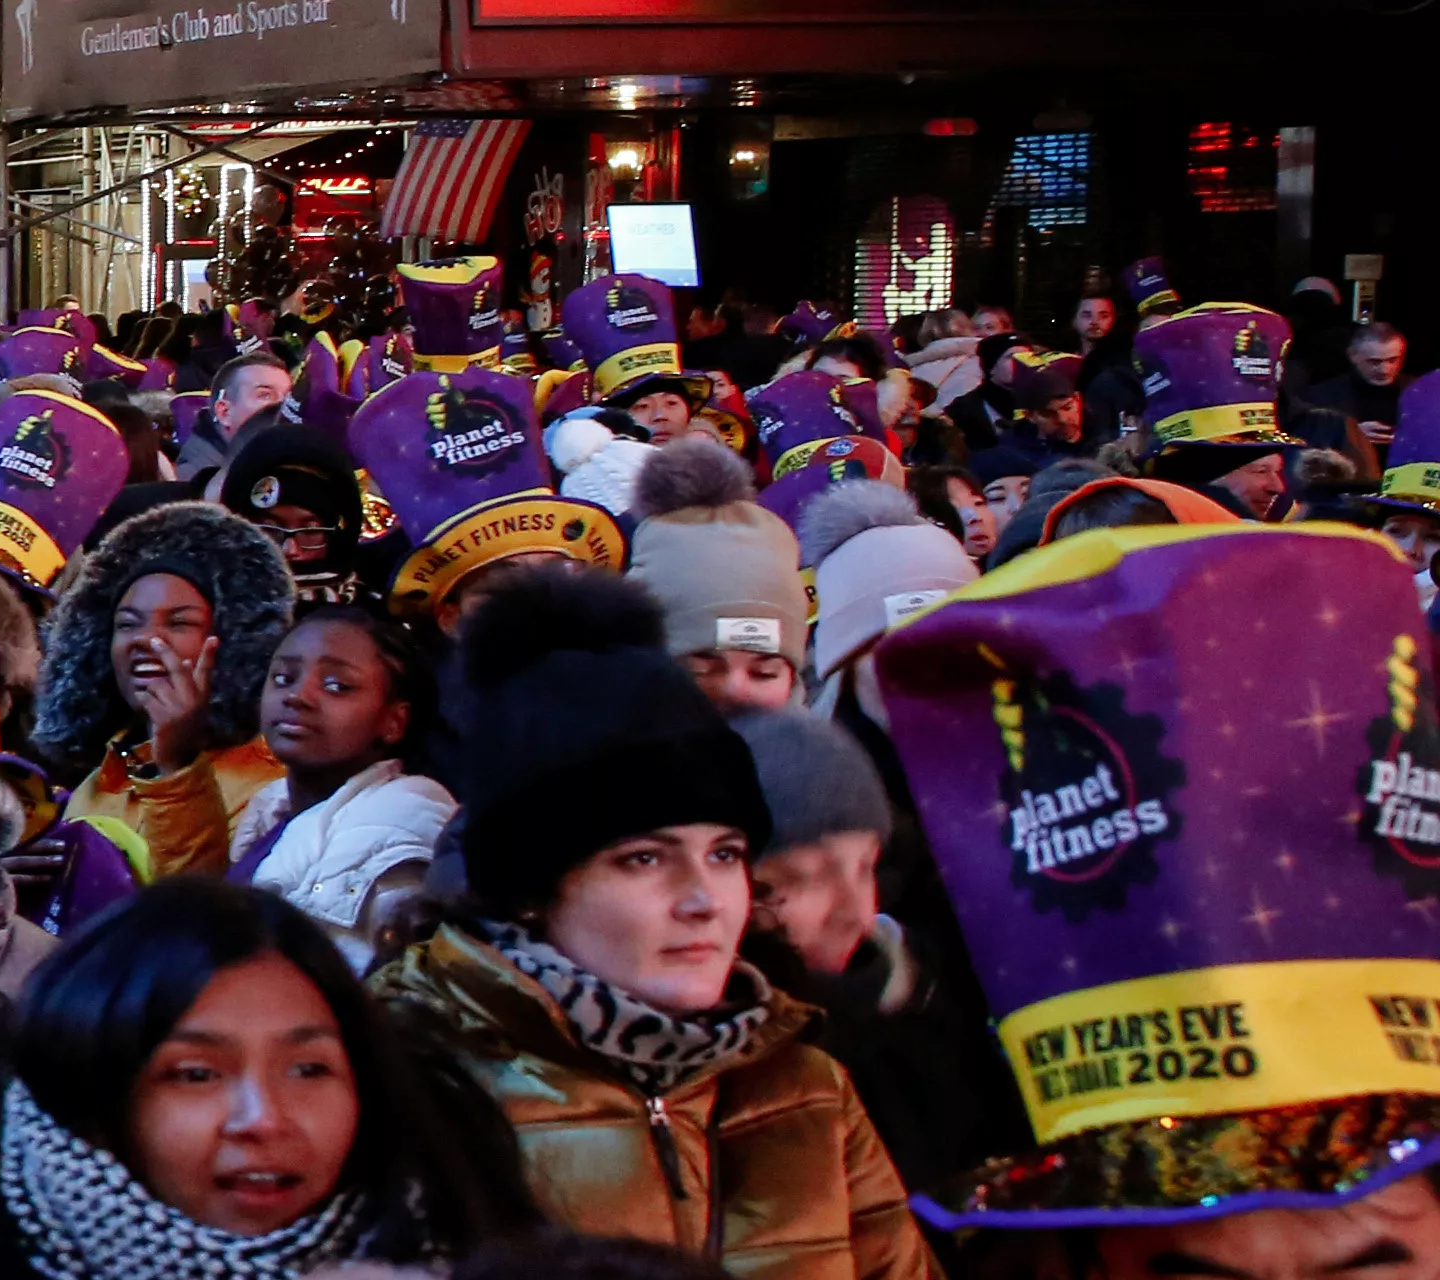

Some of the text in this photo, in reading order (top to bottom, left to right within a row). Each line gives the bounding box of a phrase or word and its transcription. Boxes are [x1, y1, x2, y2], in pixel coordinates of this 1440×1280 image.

[80, 15, 170, 57] Gentlemen's
[171, 8, 209, 44] Club
[214, 3, 242, 37] and
[431, 419, 504, 461] planet
[445, 429, 526, 467] fitness
[0, 456, 56, 488] fitness
[2, 526, 31, 552] 2020
[470, 513, 556, 547] FITNESS
[416, 538, 466, 582] PLANET
[1011, 761, 1120, 852] planet
[1027, 797, 1169, 875] fitness
[1369, 996, 1431, 1028] NEW
[1023, 1001, 1250, 1069] NEW YEAR'S EVE
[1129, 1045, 1259, 1086] 2020
